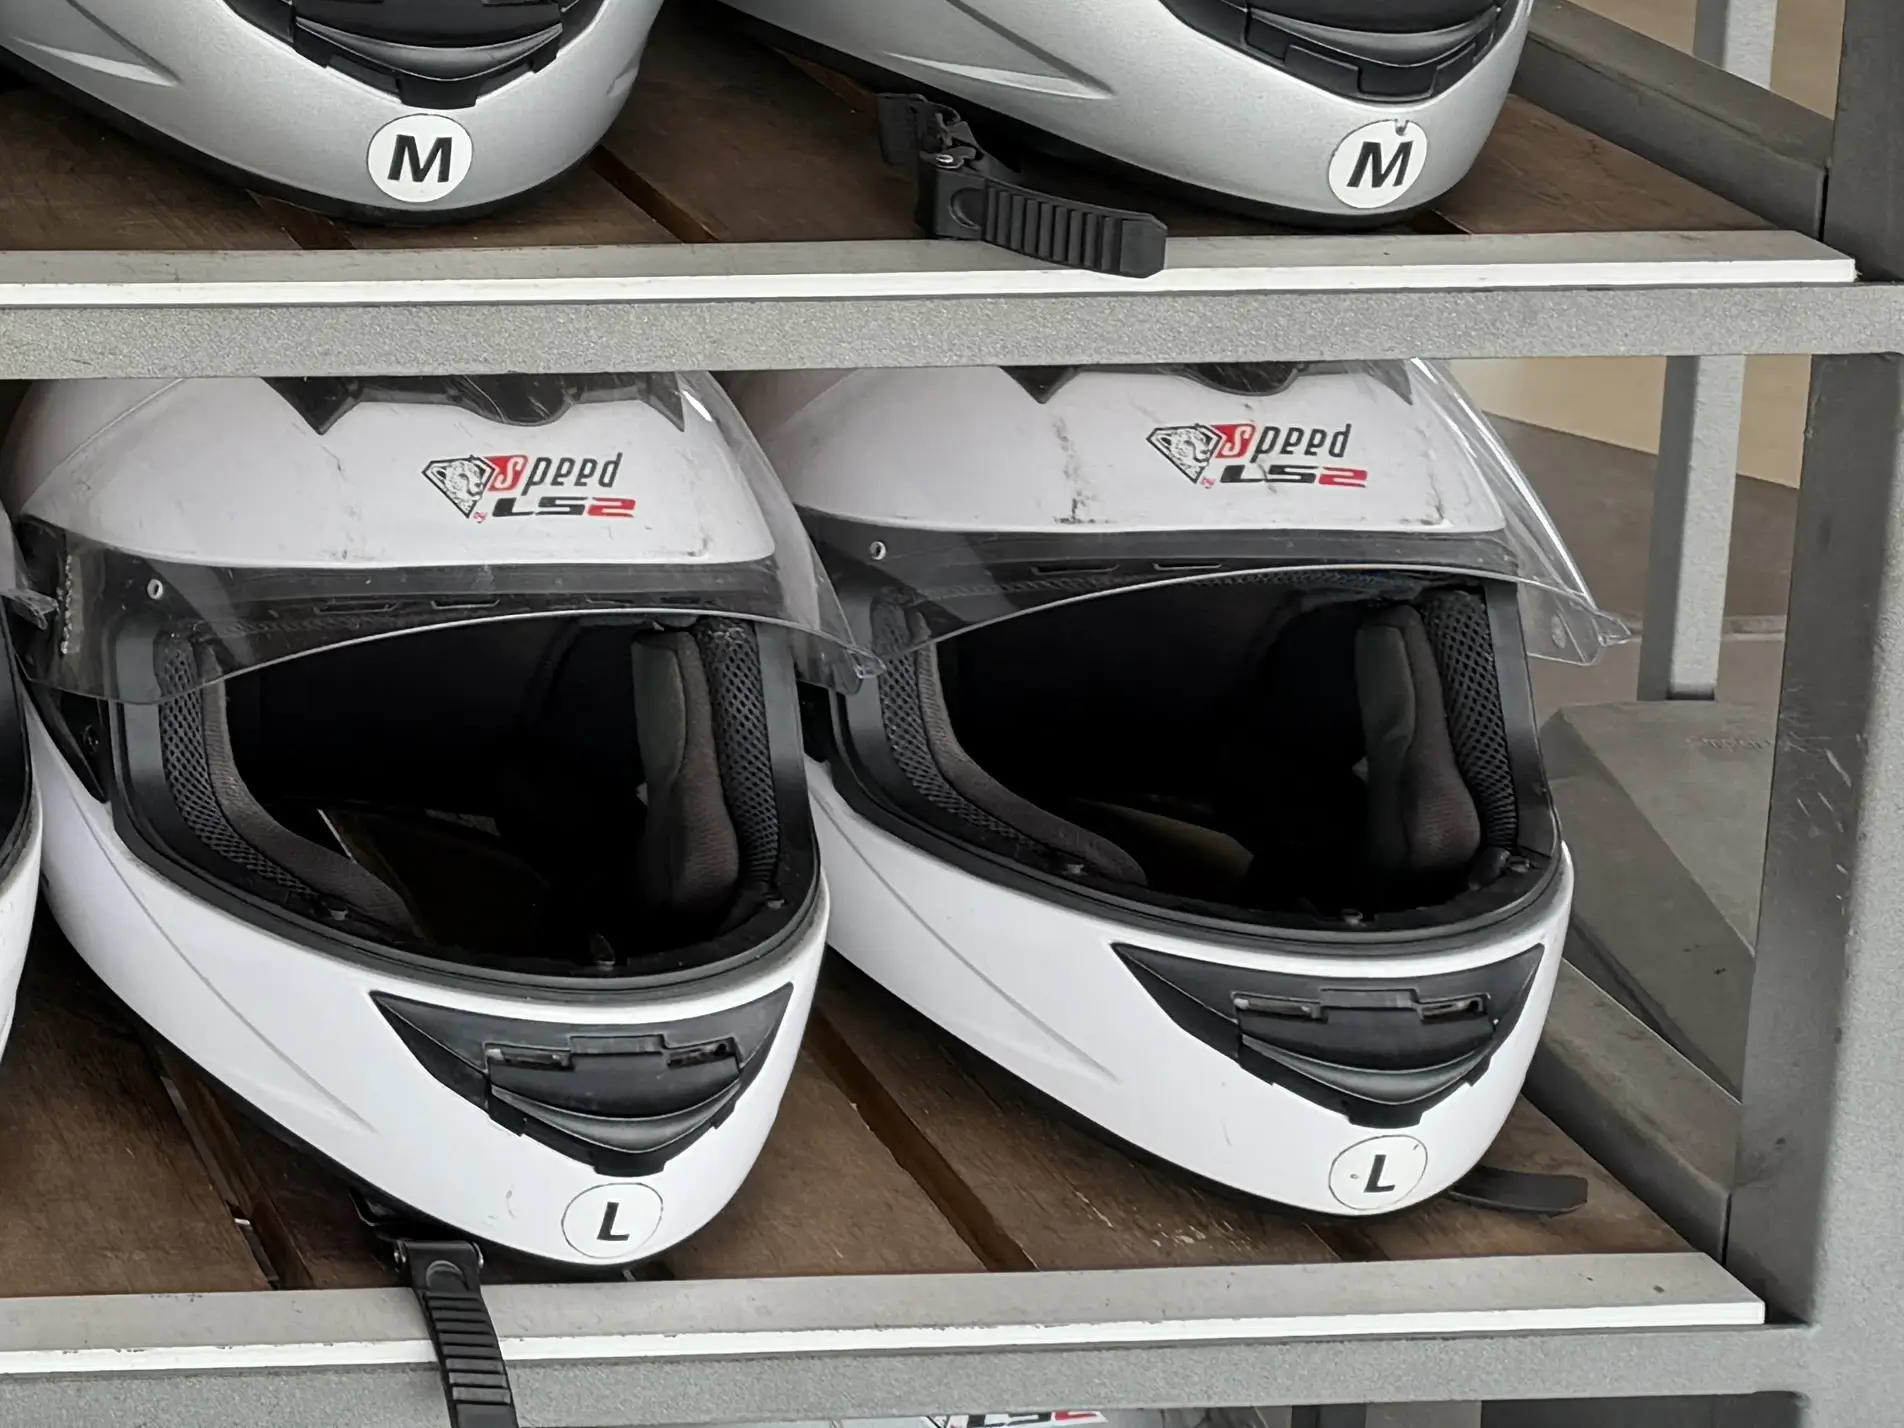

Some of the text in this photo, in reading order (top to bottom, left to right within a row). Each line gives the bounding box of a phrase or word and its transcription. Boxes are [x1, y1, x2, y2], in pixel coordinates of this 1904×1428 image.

[388, 135, 451, 182] M
[1348, 142, 1412, 187] M
[1215, 423, 1352, 463] Speed
[488, 452, 623, 496] Speed
[1219, 464, 1368, 488] LS2
[492, 496, 636, 518] LS2
[1365, 1155, 1394, 1192] L
[598, 1202, 628, 1240] L
